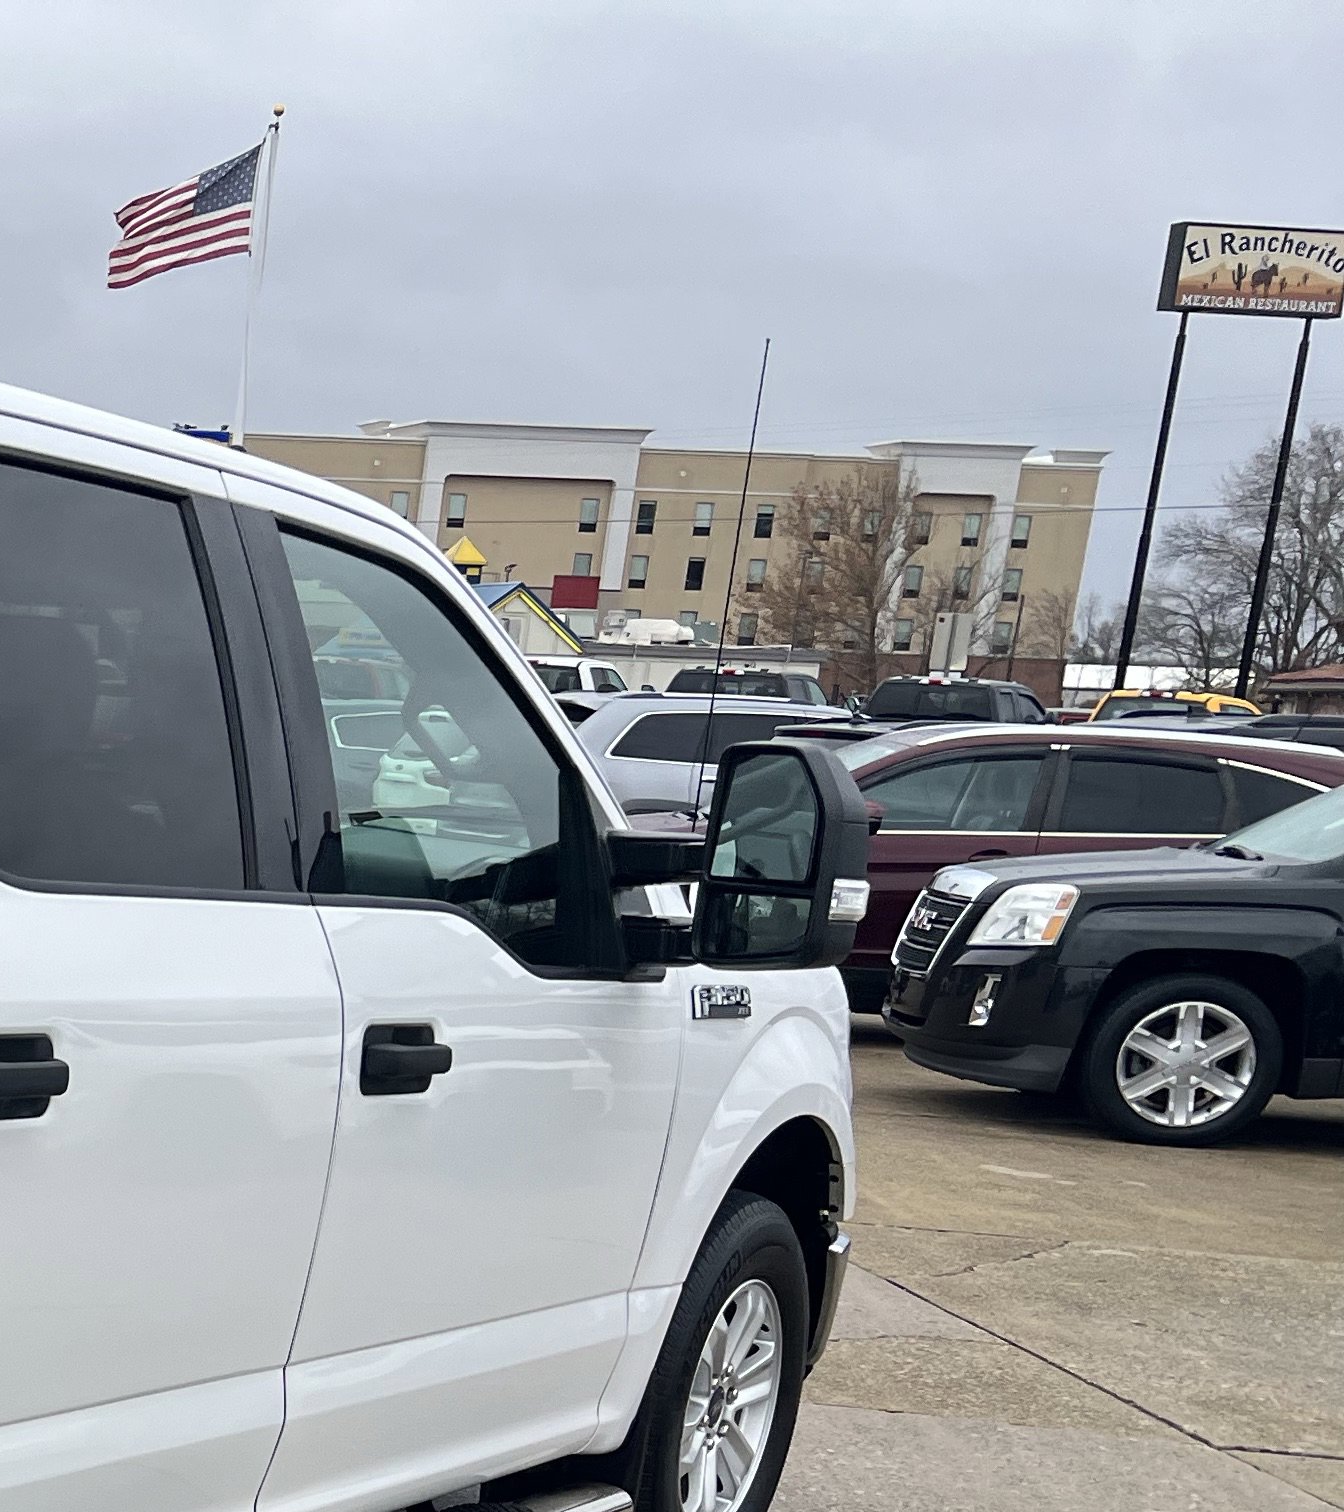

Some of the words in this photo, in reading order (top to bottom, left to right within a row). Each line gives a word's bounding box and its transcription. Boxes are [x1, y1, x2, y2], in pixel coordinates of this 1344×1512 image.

[1185, 238, 1211, 264] El
[1220, 232, 1344, 274] Rancherito
[1180, 293, 1245, 308] MEXICAN
[1247, 297, 1337, 314] RESTAURANT
